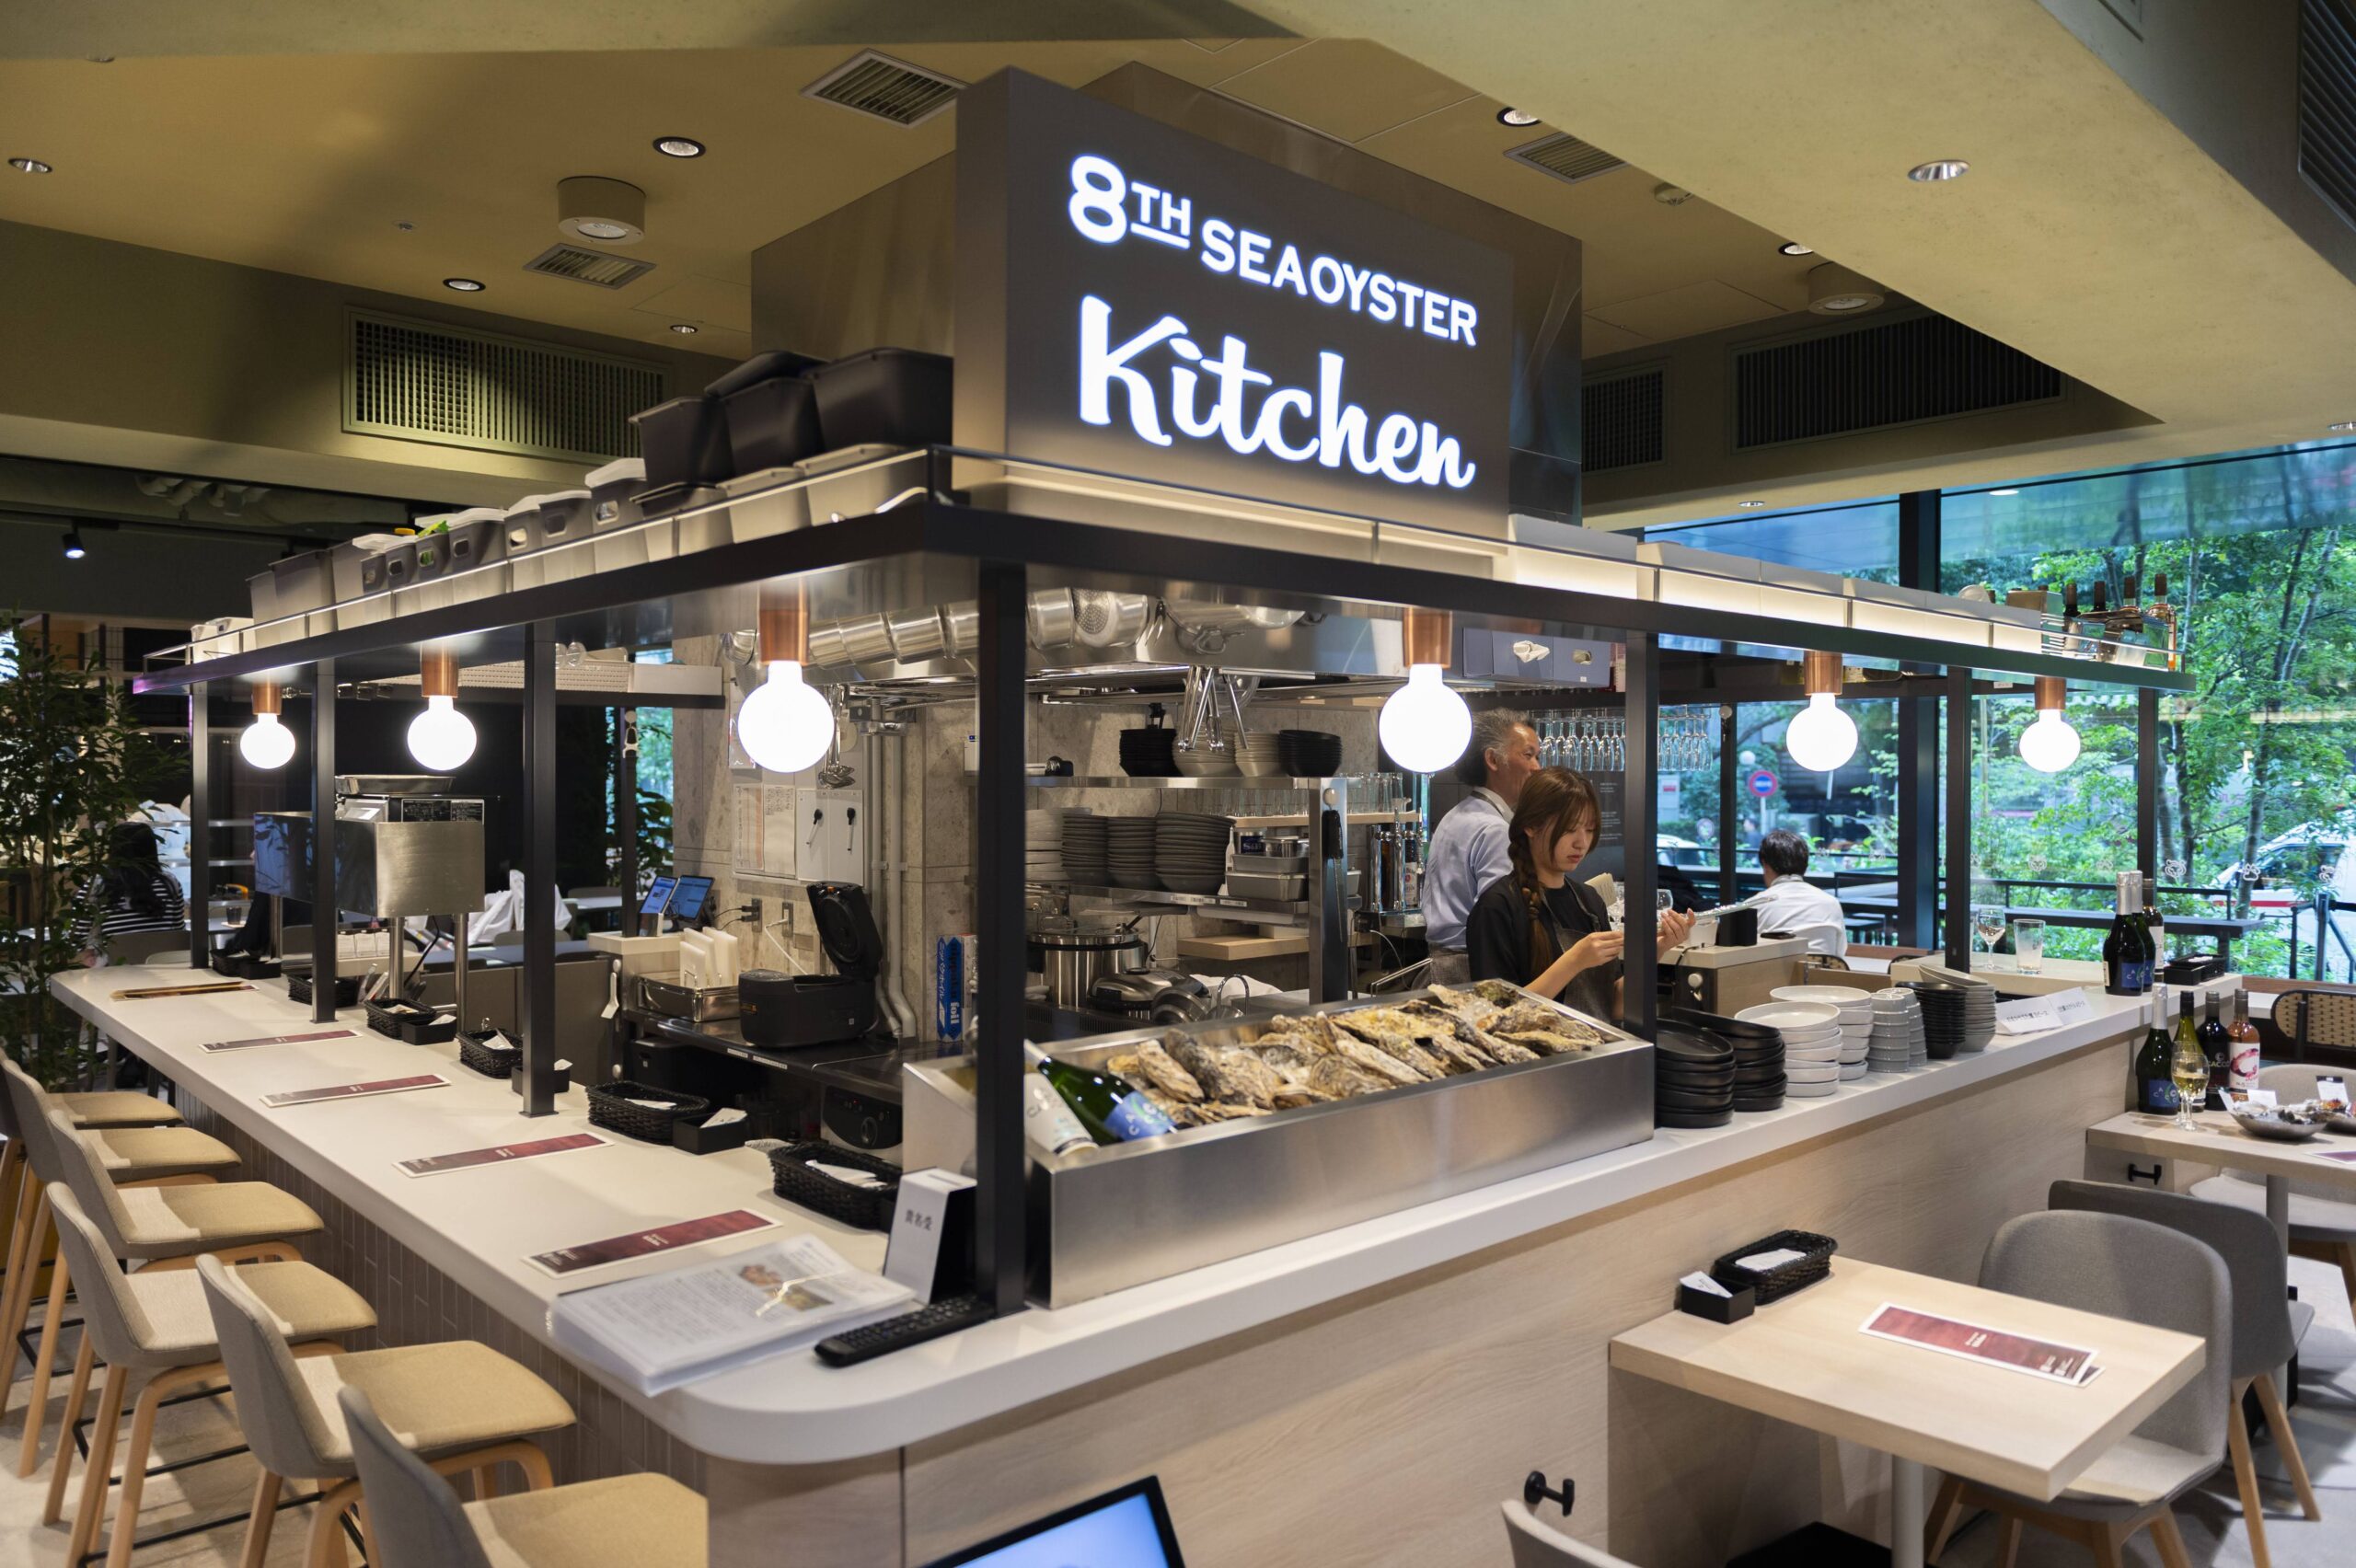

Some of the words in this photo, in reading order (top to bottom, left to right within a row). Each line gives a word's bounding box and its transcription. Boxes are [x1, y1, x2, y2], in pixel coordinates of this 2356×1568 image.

[1068, 154, 1191, 247] 8TH
[1200, 218, 1478, 348] SEAOYSTER
[1080, 294, 1476, 490] Kitchen
[950, 1001, 960, 1024] foil
